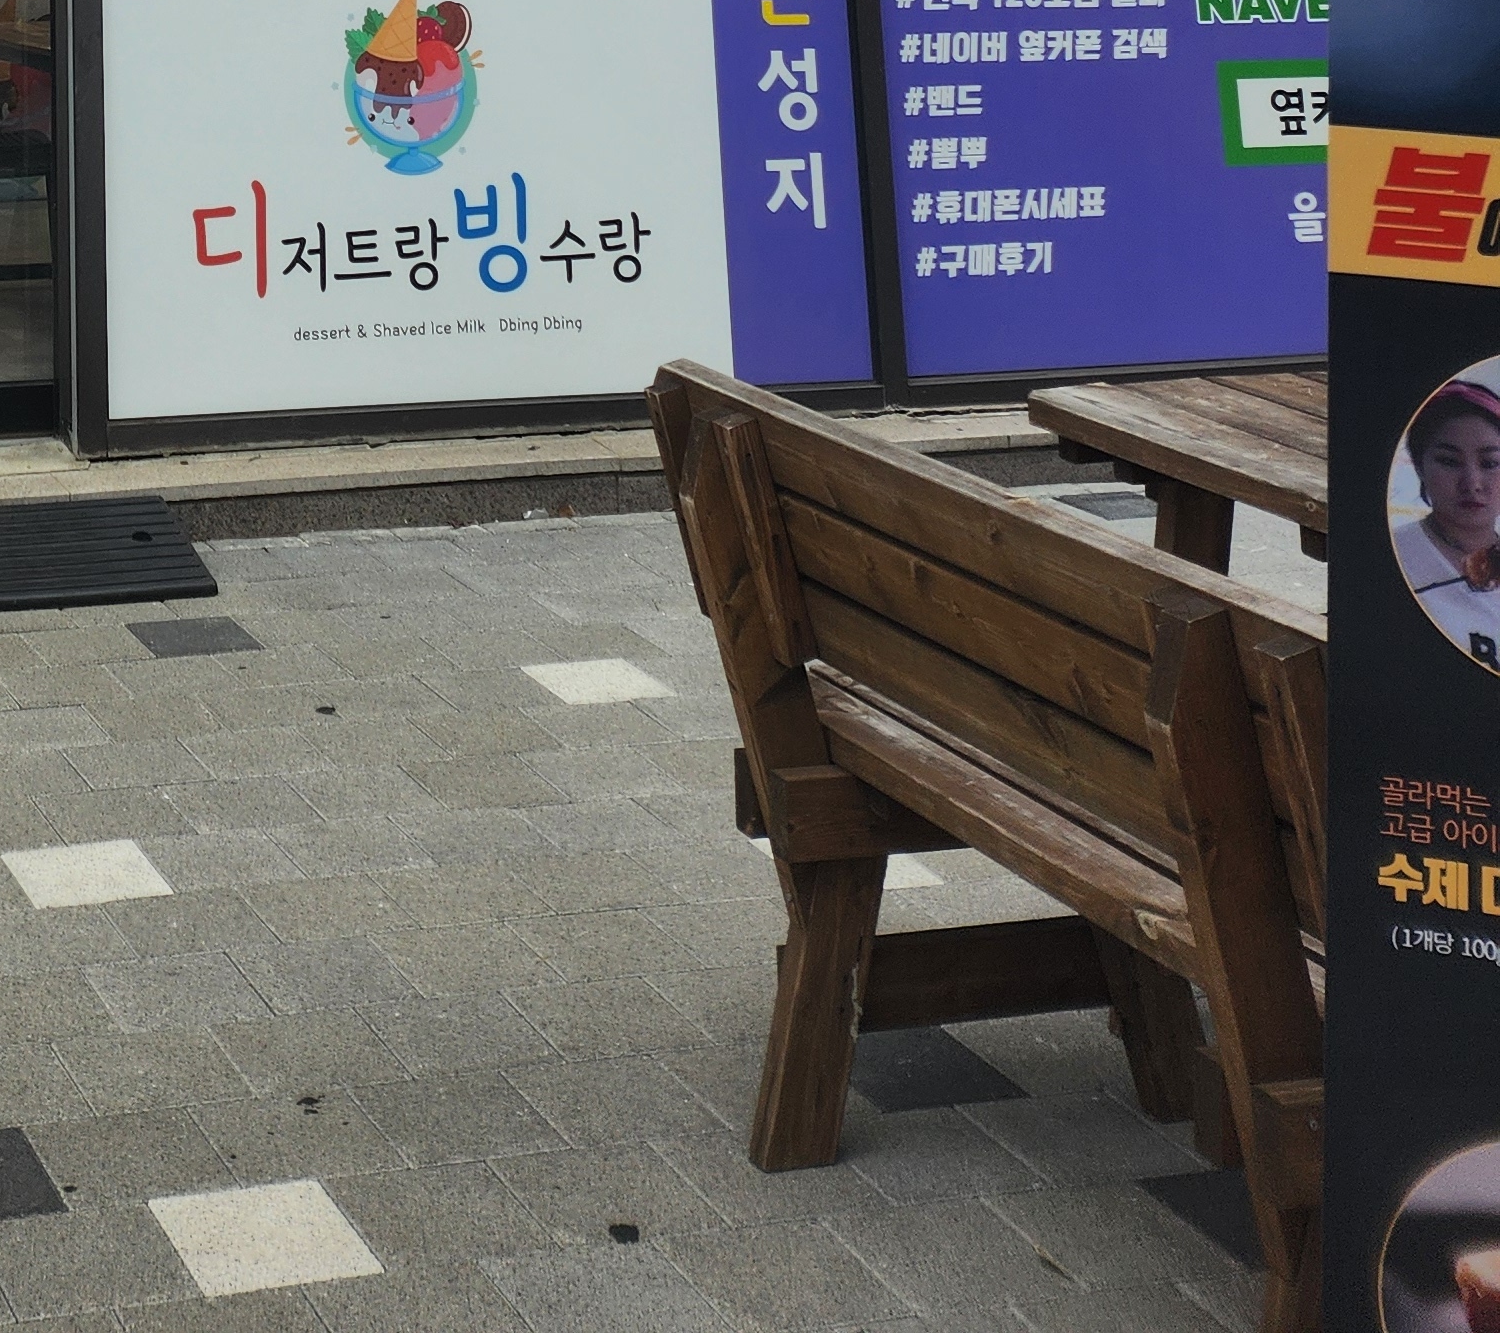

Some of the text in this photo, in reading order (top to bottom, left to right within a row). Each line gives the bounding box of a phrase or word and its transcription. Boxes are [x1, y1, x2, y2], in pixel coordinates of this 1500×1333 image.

[899, 28, 1168, 65] #네이버 옆커폰 검색
[903, 84, 983, 117] #밴드
[907, 136, 987, 169] #뽐뿌
[911, 186, 1107, 224] #휴대폰시세표
[915, 241, 1053, 279] #구매후기
[293, 324, 351, 342] dessert
[373, 321, 426, 339] Shaved
[431, 320, 452, 336] Ice
[456, 318, 486, 335] Milk
[499, 316, 539, 335] Dbing
[543, 314, 583, 334] Dbing
[1379, 776, 1492, 818] 골라먹는
[1380, 811, 1435, 845] 고급
[1377, 852, 1469, 912] 수제
[1391, 925, 1455, 955] (1개당
